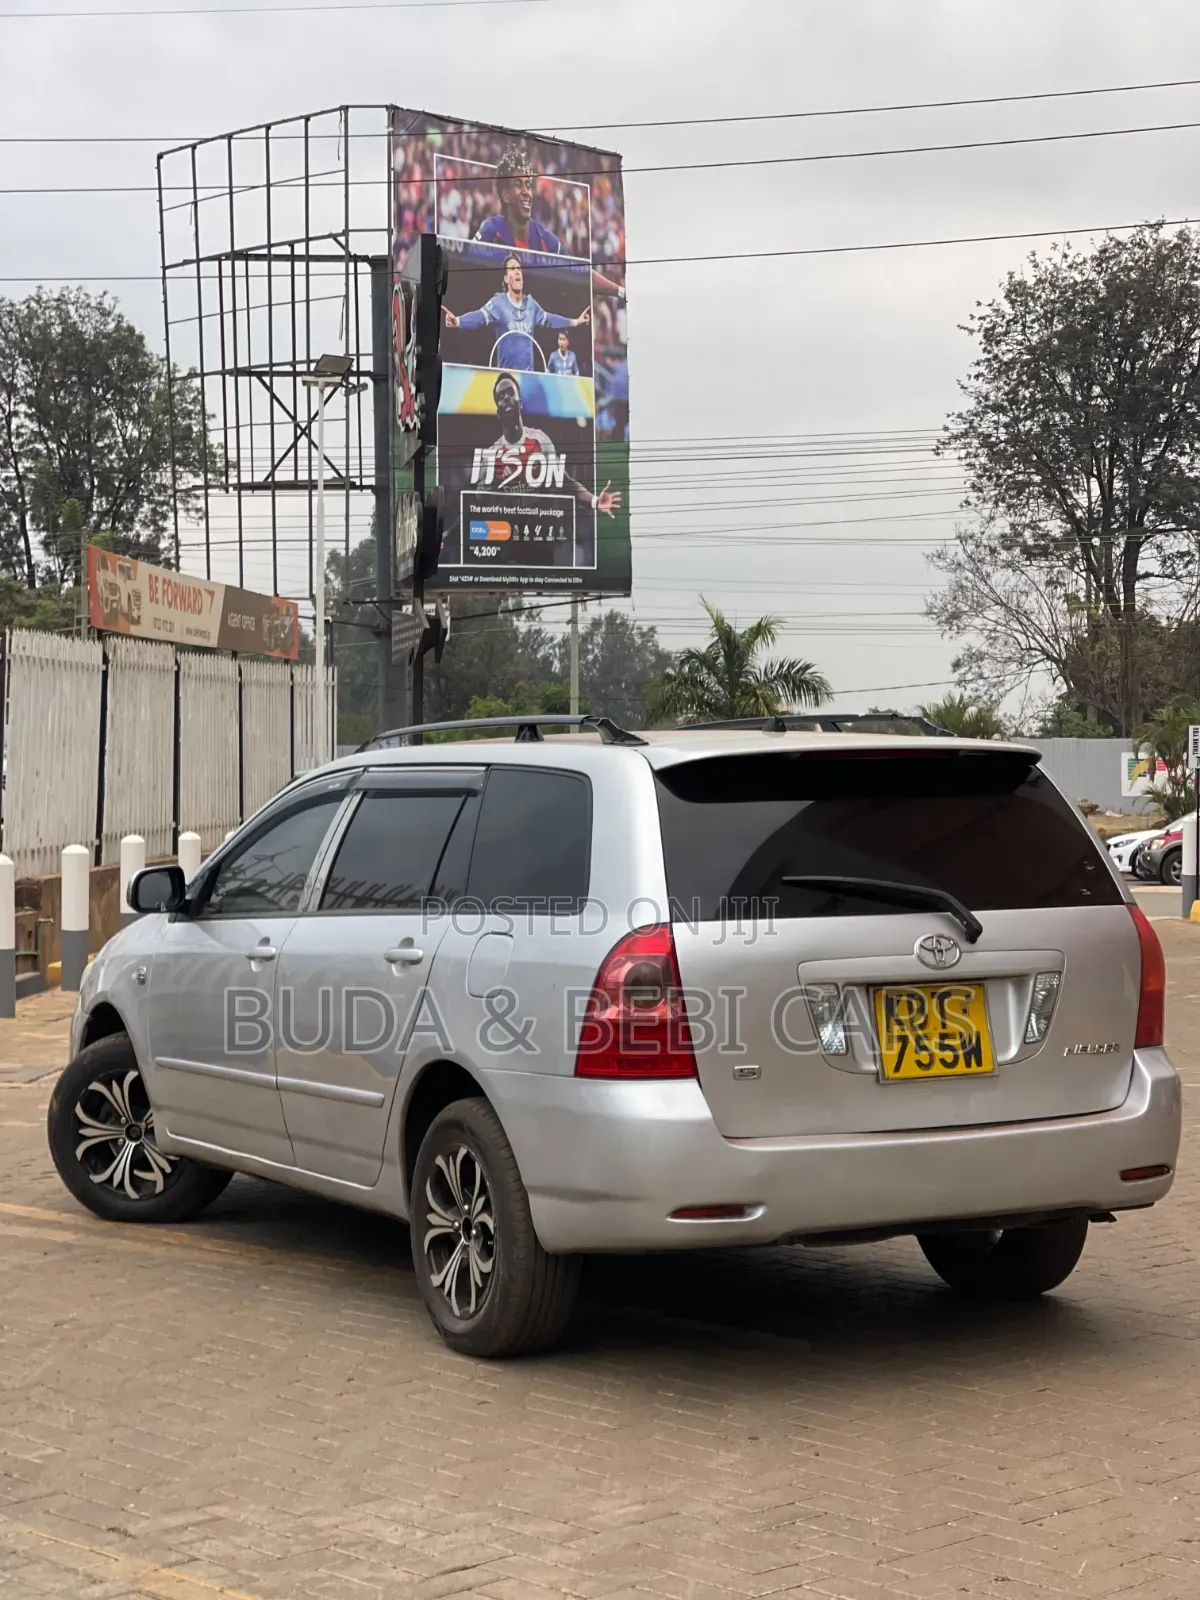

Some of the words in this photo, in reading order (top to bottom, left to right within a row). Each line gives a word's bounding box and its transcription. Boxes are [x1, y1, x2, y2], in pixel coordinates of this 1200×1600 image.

[470, 448, 523, 489] IT'S
[525, 452, 567, 488] ON
[469, 505, 481, 513] The
[482, 505, 502, 514] world's
[503, 506, 517, 515] best
[517, 506, 538, 515] football
[539, 508, 564, 518] package
[148, 573, 160, 605] BE
[162, 577, 203, 616] FORWARD
[893, 1030, 983, 1074] 755W
